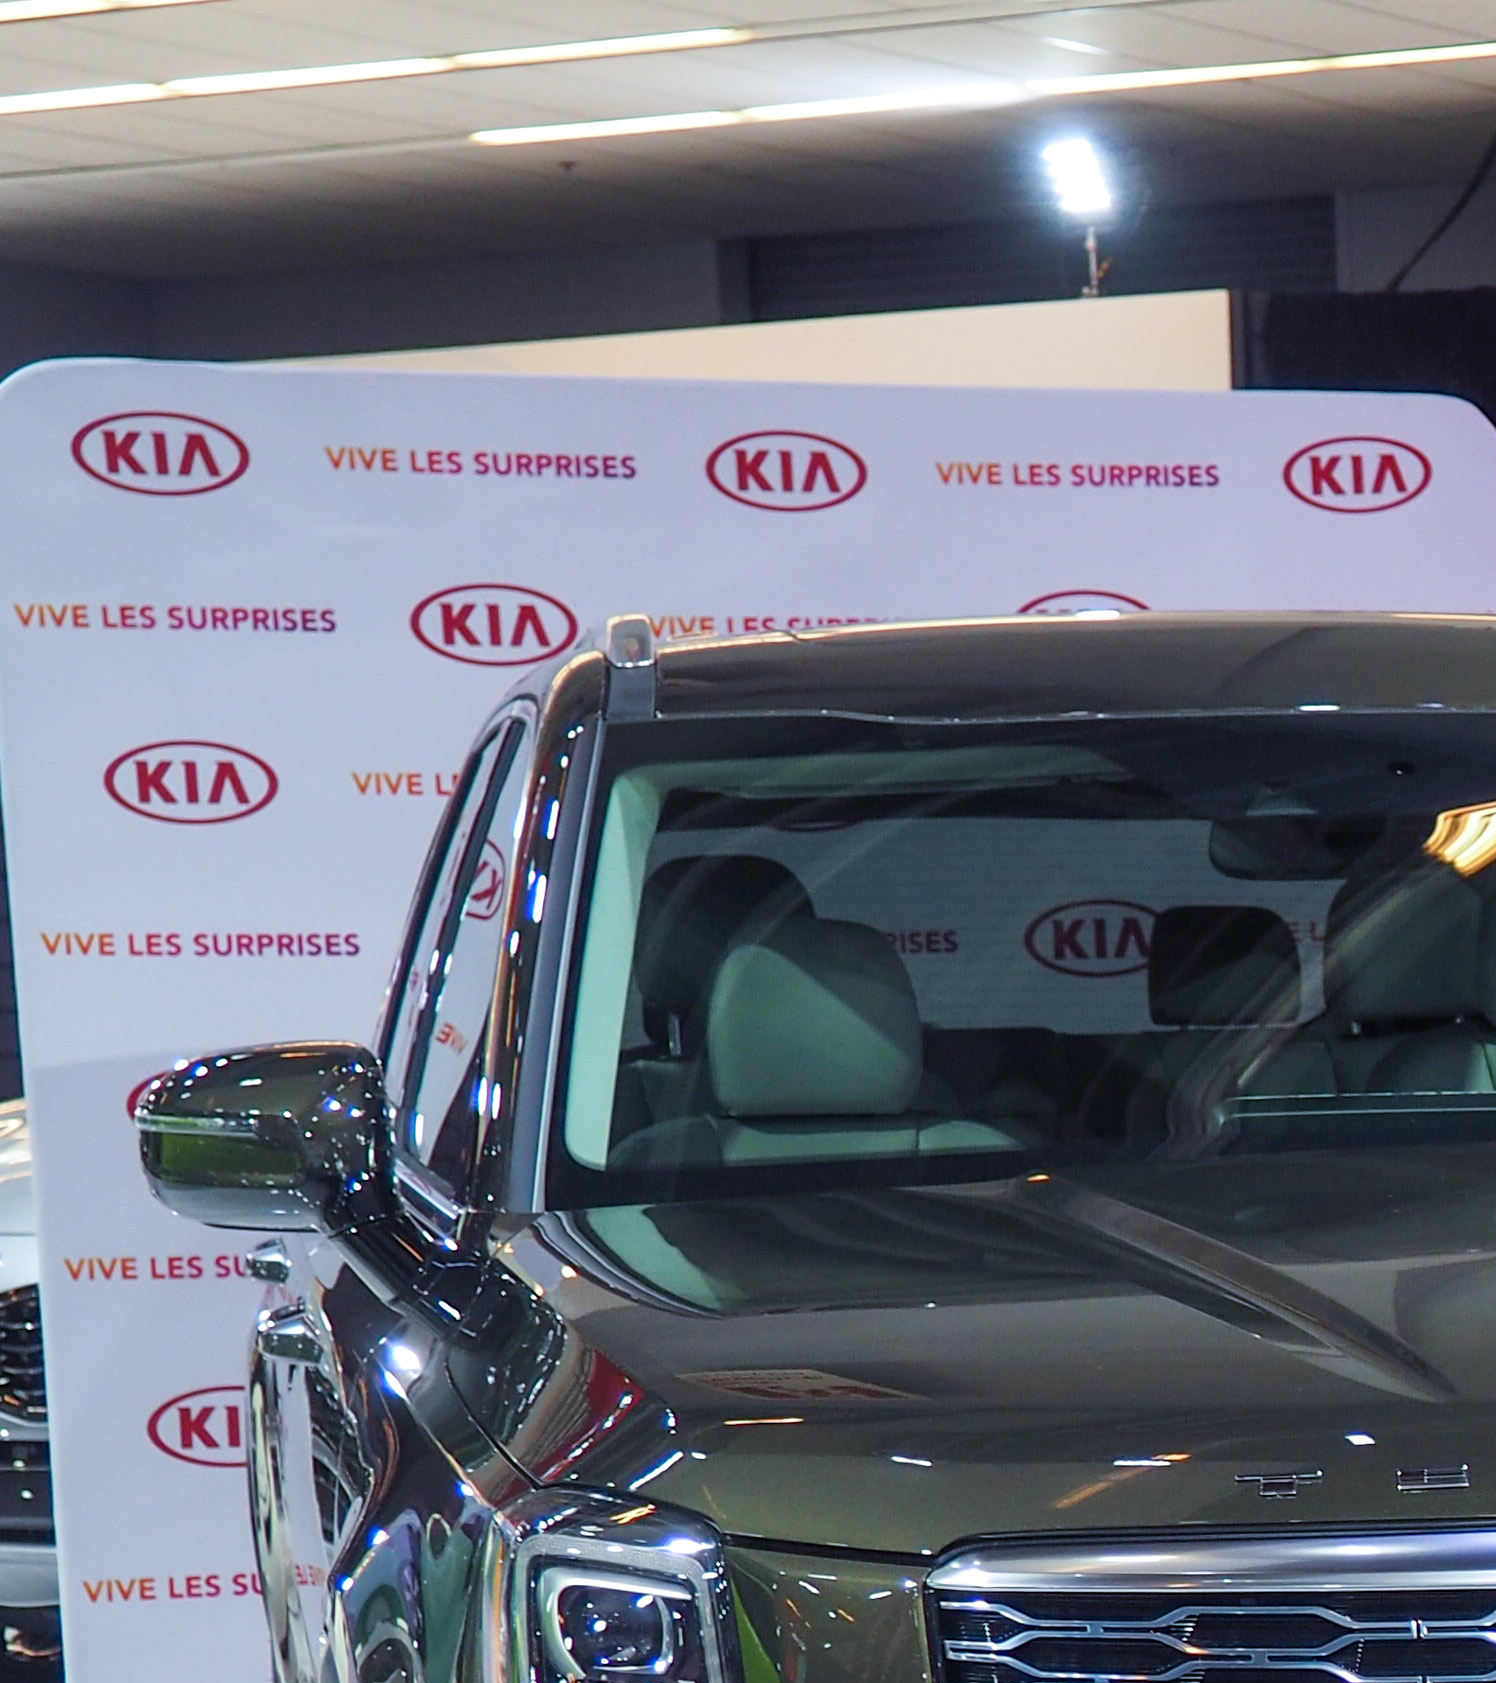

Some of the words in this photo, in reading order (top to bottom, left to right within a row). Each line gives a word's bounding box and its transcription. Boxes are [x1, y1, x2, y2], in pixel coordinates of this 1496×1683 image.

[101, 430, 223, 477] KIA
[326, 447, 399, 473] VIVE
[410, 449, 464, 476] LES
[474, 451, 638, 480] SURPRISES
[732, 447, 842, 495] KIA
[937, 461, 1003, 487] VIVE
[1013, 462, 1063, 488] LES
[1070, 463, 1221, 490] SURPRISES
[1307, 452, 1408, 498] KIA
[14, 603, 91, 630] VIVE
[102, 605, 158, 632] LES
[168, 606, 338, 634] SURPRISES
[438, 602, 552, 648] KIA
[133, 759, 251, 806] KIA
[352, 772, 424, 797] VIVE
[40, 932, 117, 957] VIVE
[127, 932, 184, 958] LES
[193, 933, 362, 959] SURPRISES
[65, 1257, 139, 1282] VIVE
[150, 1256, 205, 1281] LES
[83, 1577, 158, 1604] VIVE
[168, 1575, 223, 1601] LES
